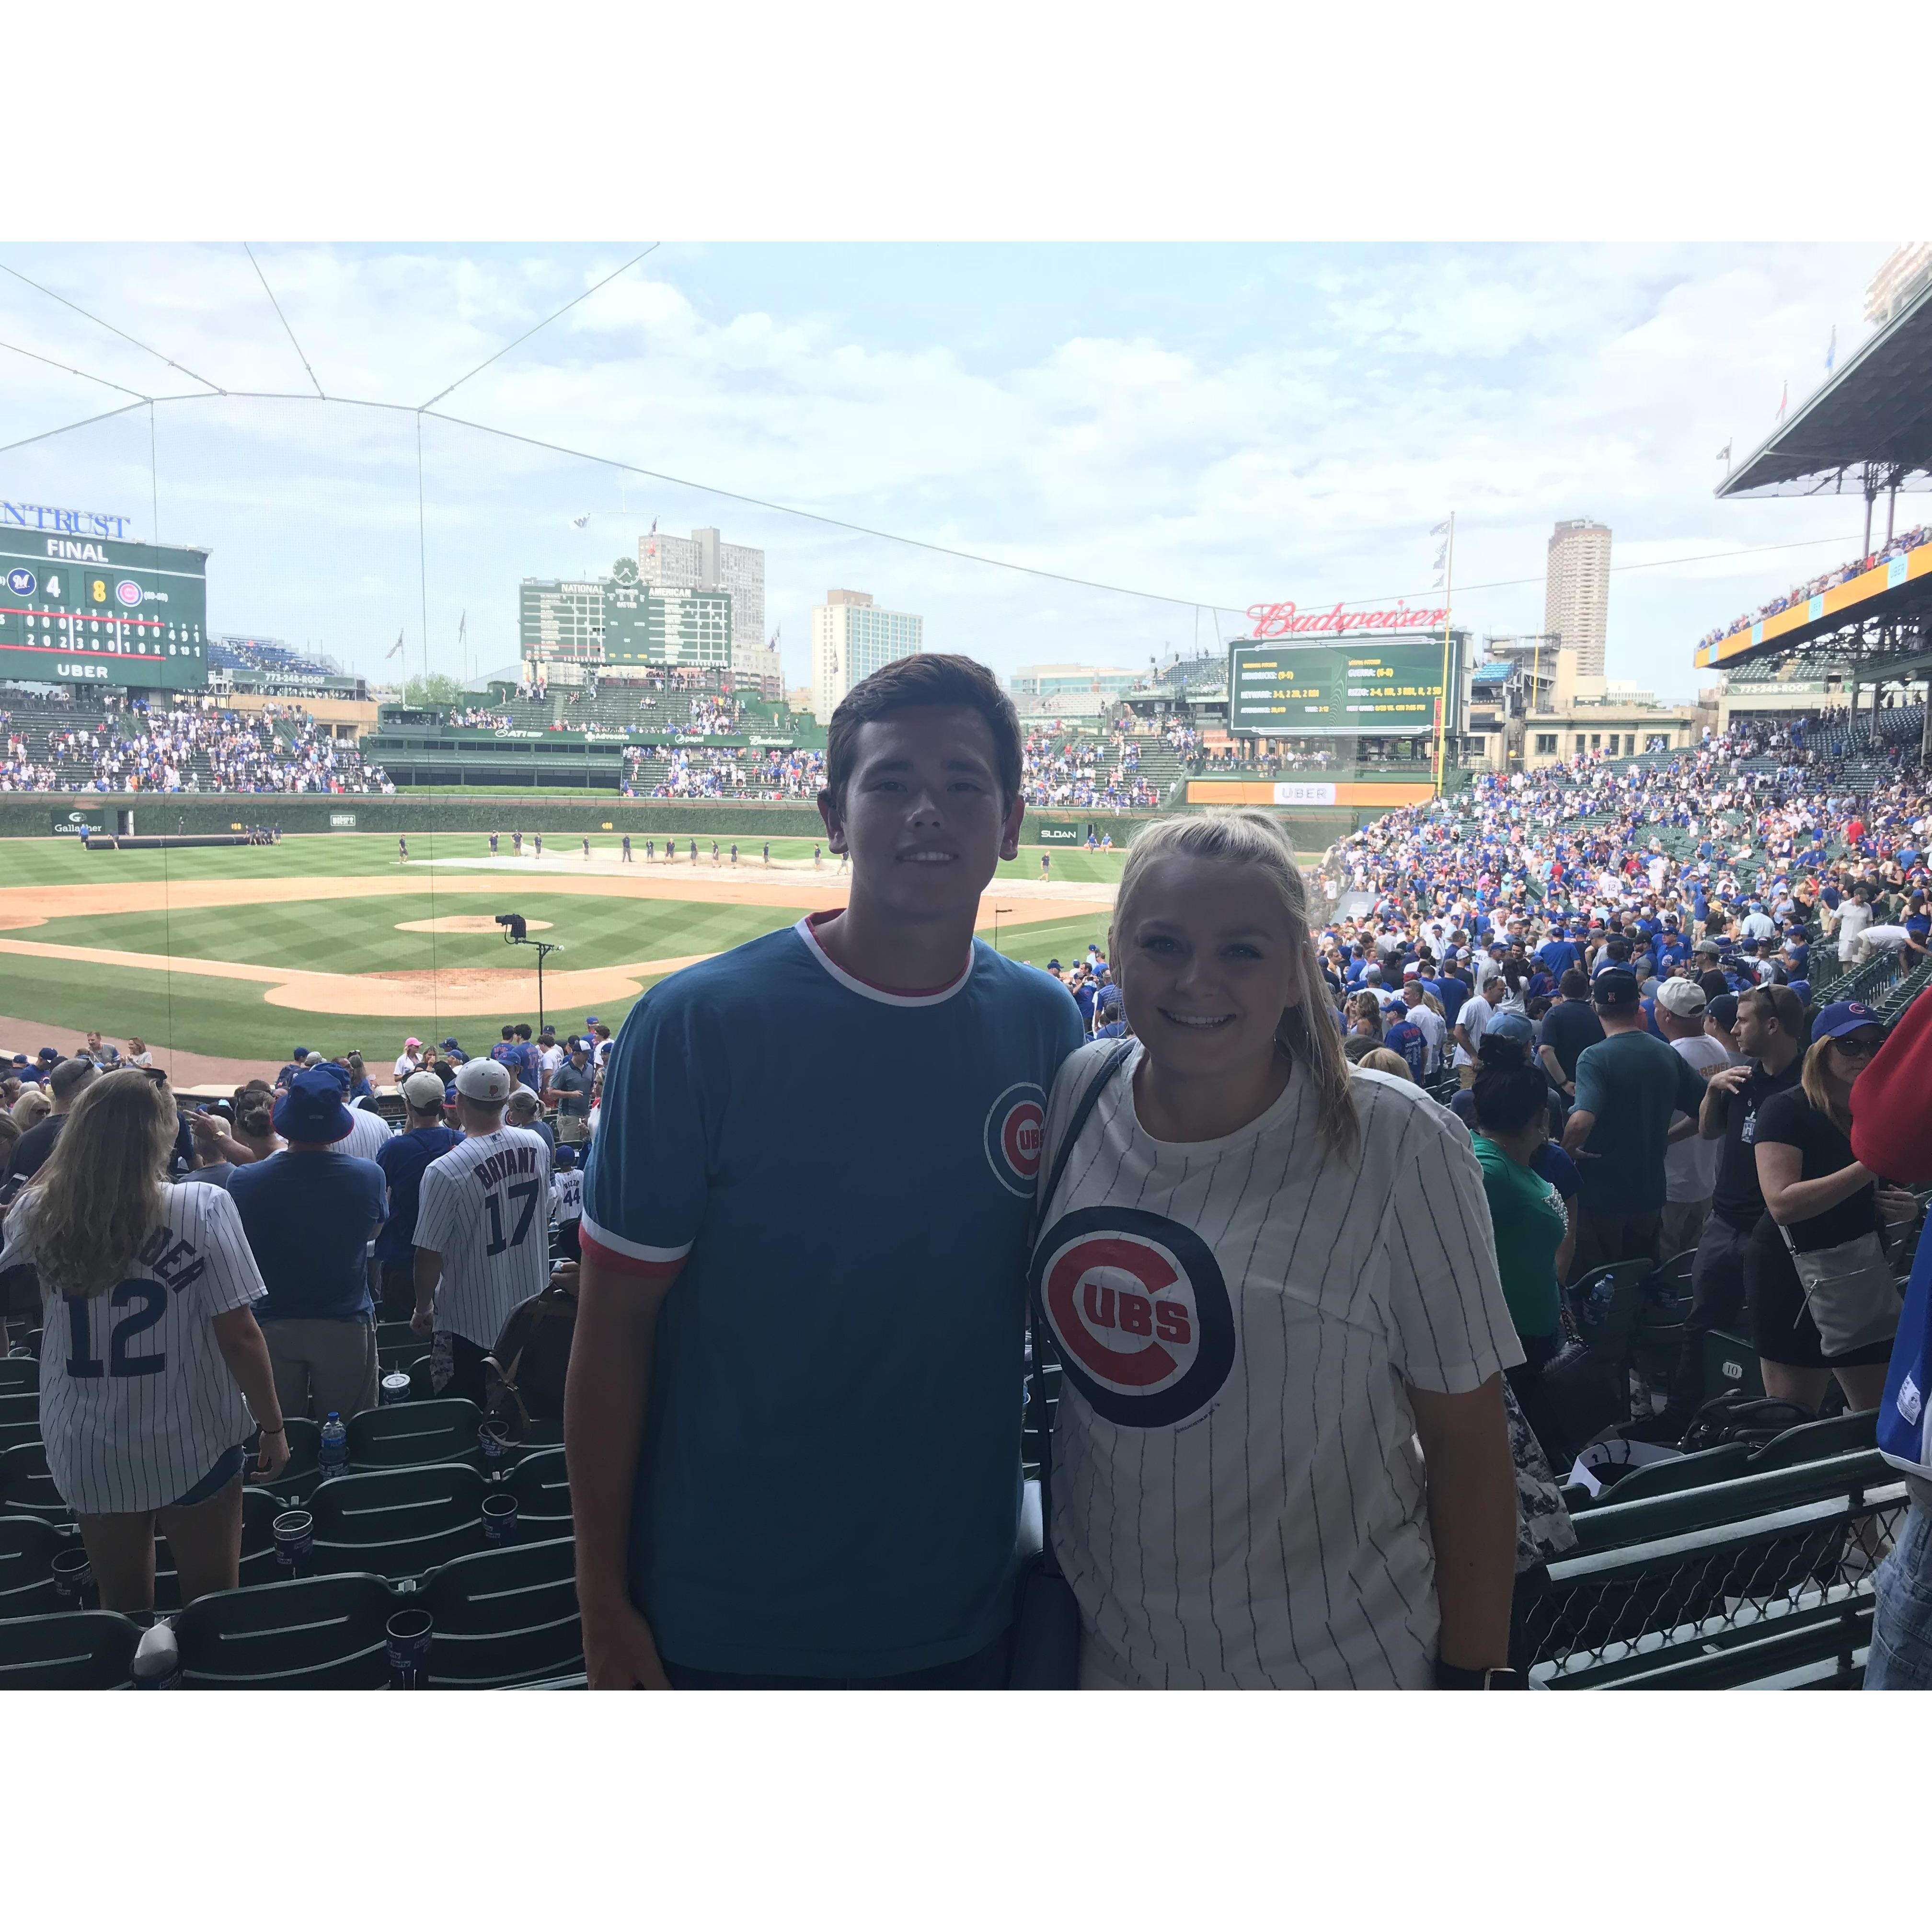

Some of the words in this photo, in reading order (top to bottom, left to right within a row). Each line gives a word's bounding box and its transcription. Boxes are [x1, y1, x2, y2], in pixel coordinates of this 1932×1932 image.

[47, 539, 109, 563] FINAL
[46, 576, 61, 597] 4
[93, 580, 106, 602] 8
[562, 584, 605, 594] NATIONAL
[649, 587, 691, 598] AMERICAN
[44, 605, 49, 613] 2
[1246, 599, 1451, 638] Budweiser
[27, 616, 34, 627] 0
[43, 617, 50, 628] 0
[59, 618, 66, 629] 0
[76, 620, 83, 631] 2
[92, 621, 98, 632] 0
[107, 622, 113, 633] 0
[124, 624, 130, 635] 2
[138, 625, 145, 636] 0
[153, 626, 160, 637] 0
[169, 630, 175, 640] 4
[181, 631, 188, 642] 9
[194, 632, 199, 643] 1
[27, 634, 34, 645] 2
[44, 635, 50, 646] 0
[60, 637, 67, 648] 2
[77, 638, 83, 649] 3
[92, 639, 99, 650] 0
[108, 641, 115, 651] 0
[124, 642, 130, 652] 1
[138, 643, 145, 654] 0
[170, 644, 176, 655] 8
[195, 646, 199, 657] 1
[58, 664, 108, 678] UBER
[265, 673, 325, 684] 773-248-ROOF
[1426, 687, 1431, 695] 2
[1282, 787, 1326, 799] UBER
[1041, 830, 1076, 838] SLOAN
[473, 1147, 537, 1190] BRYANT
[564, 1180, 579, 1190] RIZZO
[563, 1188, 580, 1207] 44
[485, 1179, 539, 1257] 17
[62, 1278, 168, 1378] 12
[1727, 1365, 1738, 1376] 10
